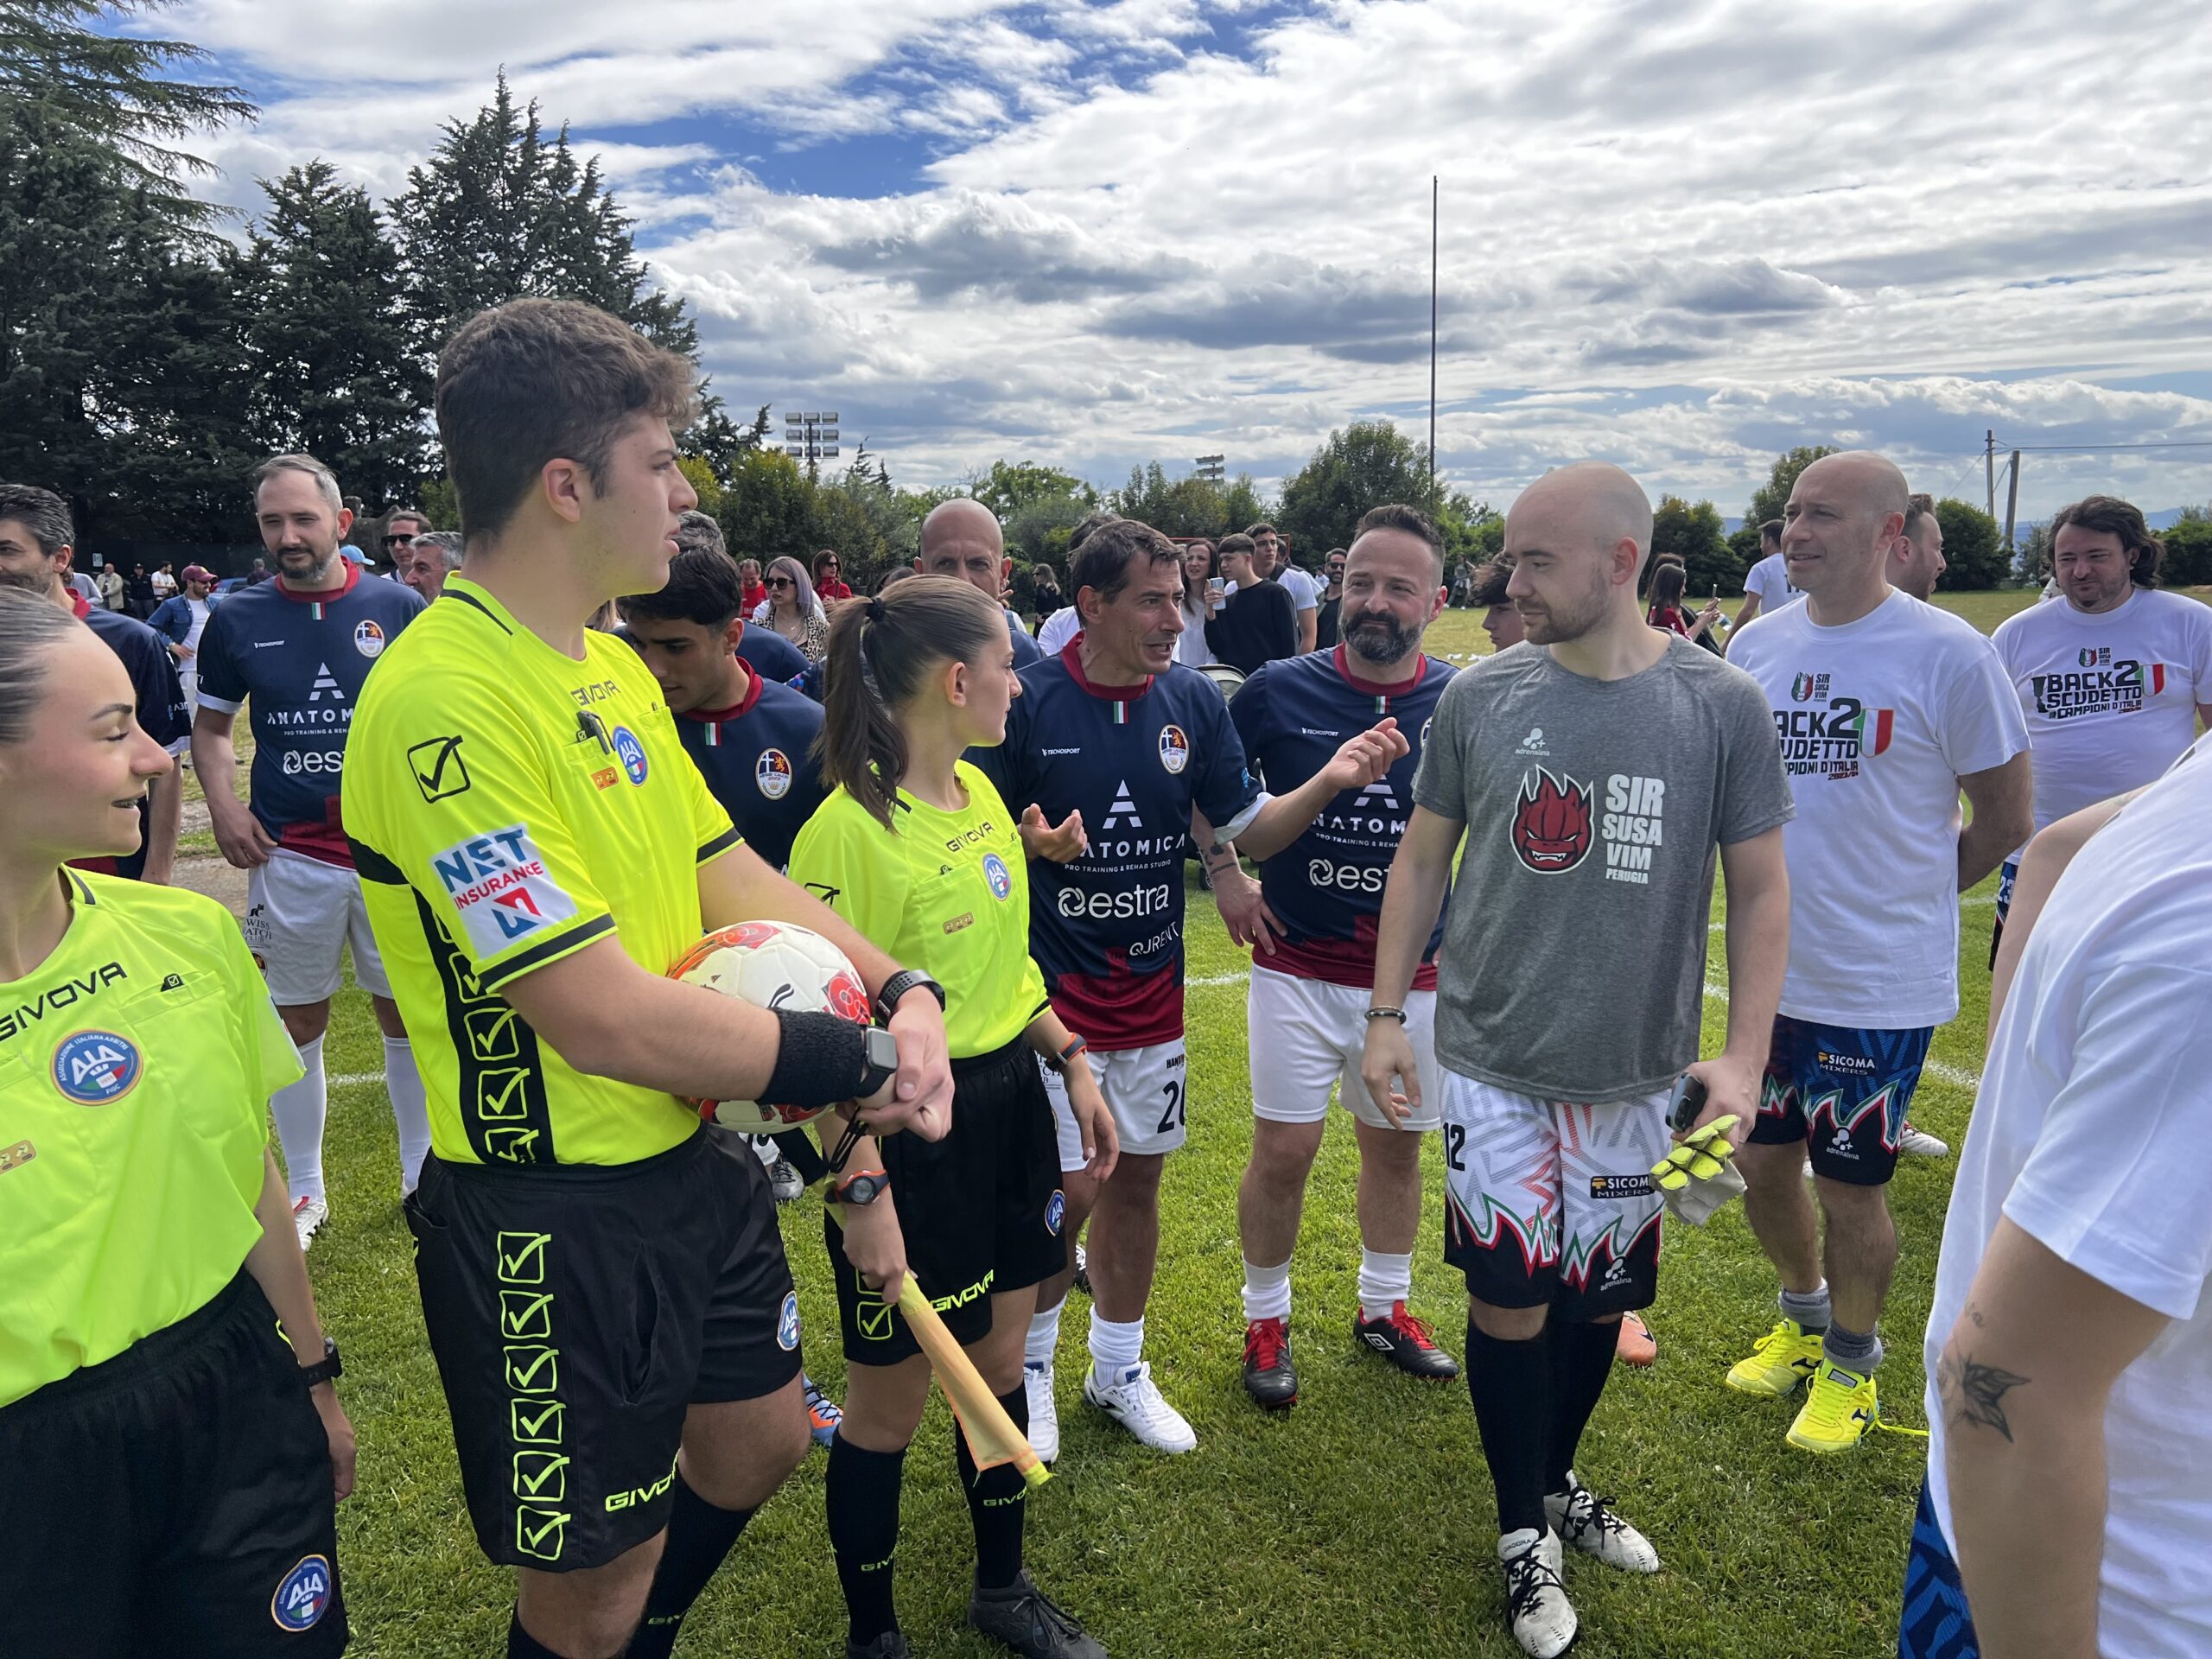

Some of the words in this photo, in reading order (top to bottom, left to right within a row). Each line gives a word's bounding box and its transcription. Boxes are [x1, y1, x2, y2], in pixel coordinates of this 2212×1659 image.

[1815, 673, 1831, 683] SIR
[2046, 686, 2142, 709] SCUDETTO
[267, 707, 353, 725] ANATOM
[1773, 697, 1861, 739] ACK2
[2057, 702, 2110, 719] CAMPIONI
[1515, 748, 1550, 757] adrenalina
[1780, 739, 1859, 760] UDETTO
[1784, 761, 1818, 776] PIONI
[1605, 773, 1666, 817] SIR
[1312, 813, 1407, 836] NATOM
[1601, 813, 1662, 846] SUSA
[945, 821, 995, 853] GIVOVA
[1080, 833, 1185, 860] ATOMICA
[1332, 836, 1370, 847] TRAINING
[434, 829, 527, 893] NET
[1065, 863, 1080, 872] PRO
[1126, 862, 1148, 871] REHAB
[1150, 859, 1172, 868] STUDIO
[1606, 842, 1652, 871] VIM
[453, 861, 543, 911] INSURANCE
[1605, 868, 1649, 884] PERUGIA
[1997, 875, 2015, 905] 23
[1088, 883, 1170, 919] estra
[245, 918, 270, 931] WISS
[245, 927, 272, 940] ATCH
[71, 1045, 127, 1086] AIA
[1819, 1064, 1868, 1076] MIXERS
[1828, 1054, 1875, 1069] SICOMA
[105, 1084, 121, 1095] FIGC
[1443, 1122, 1465, 1172] 12
[1826, 1146, 1859, 1160] adrenalina
[1597, 1189, 1650, 1198] MIXERS
[1607, 1176, 1649, 1190] SICOM
[929, 1268, 994, 1313] GIVOVA
[605, 1455, 677, 1512] GIVO
[982, 1486, 1027, 1507] GIVO
